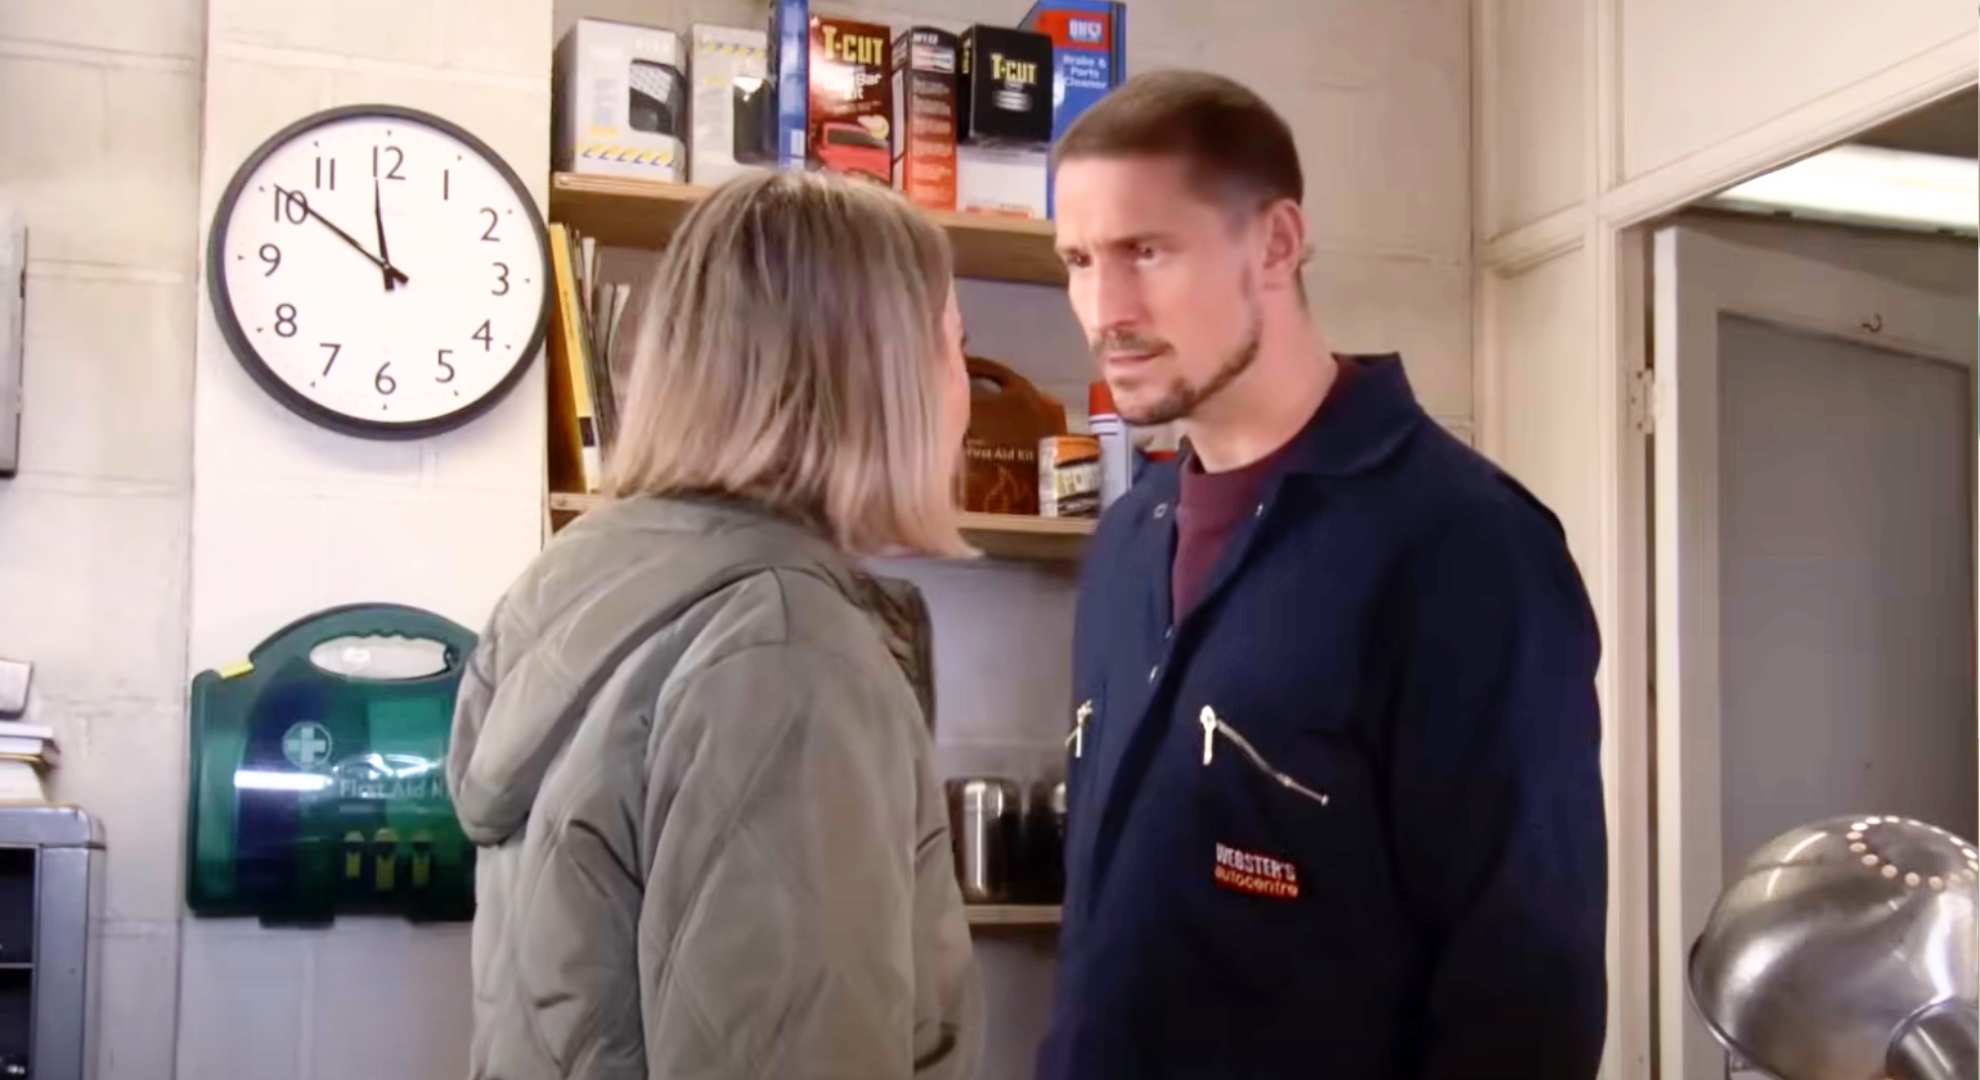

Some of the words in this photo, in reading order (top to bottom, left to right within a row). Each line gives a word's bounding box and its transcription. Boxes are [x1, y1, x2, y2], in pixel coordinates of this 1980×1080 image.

[315, 156, 336, 191] 11
[372, 145, 406, 181] 12
[442, 168, 449, 201] 1
[273, 187, 309, 225] 10
[479, 207, 501, 242] 2
[258, 243, 282, 277] 9
[491, 262, 510, 296] 3
[274, 303, 298, 338] 8
[471, 318, 494, 351] 4
[319, 342, 342, 377] 7
[435, 349, 456, 383] 5
[374, 361, 396, 395] 6
[994, 446, 1015, 460] Aid
[393, 779, 427, 799] Aid
[1216, 842, 1296, 882] WEBSTER'S
[1214, 864, 1299, 898] autocentre
